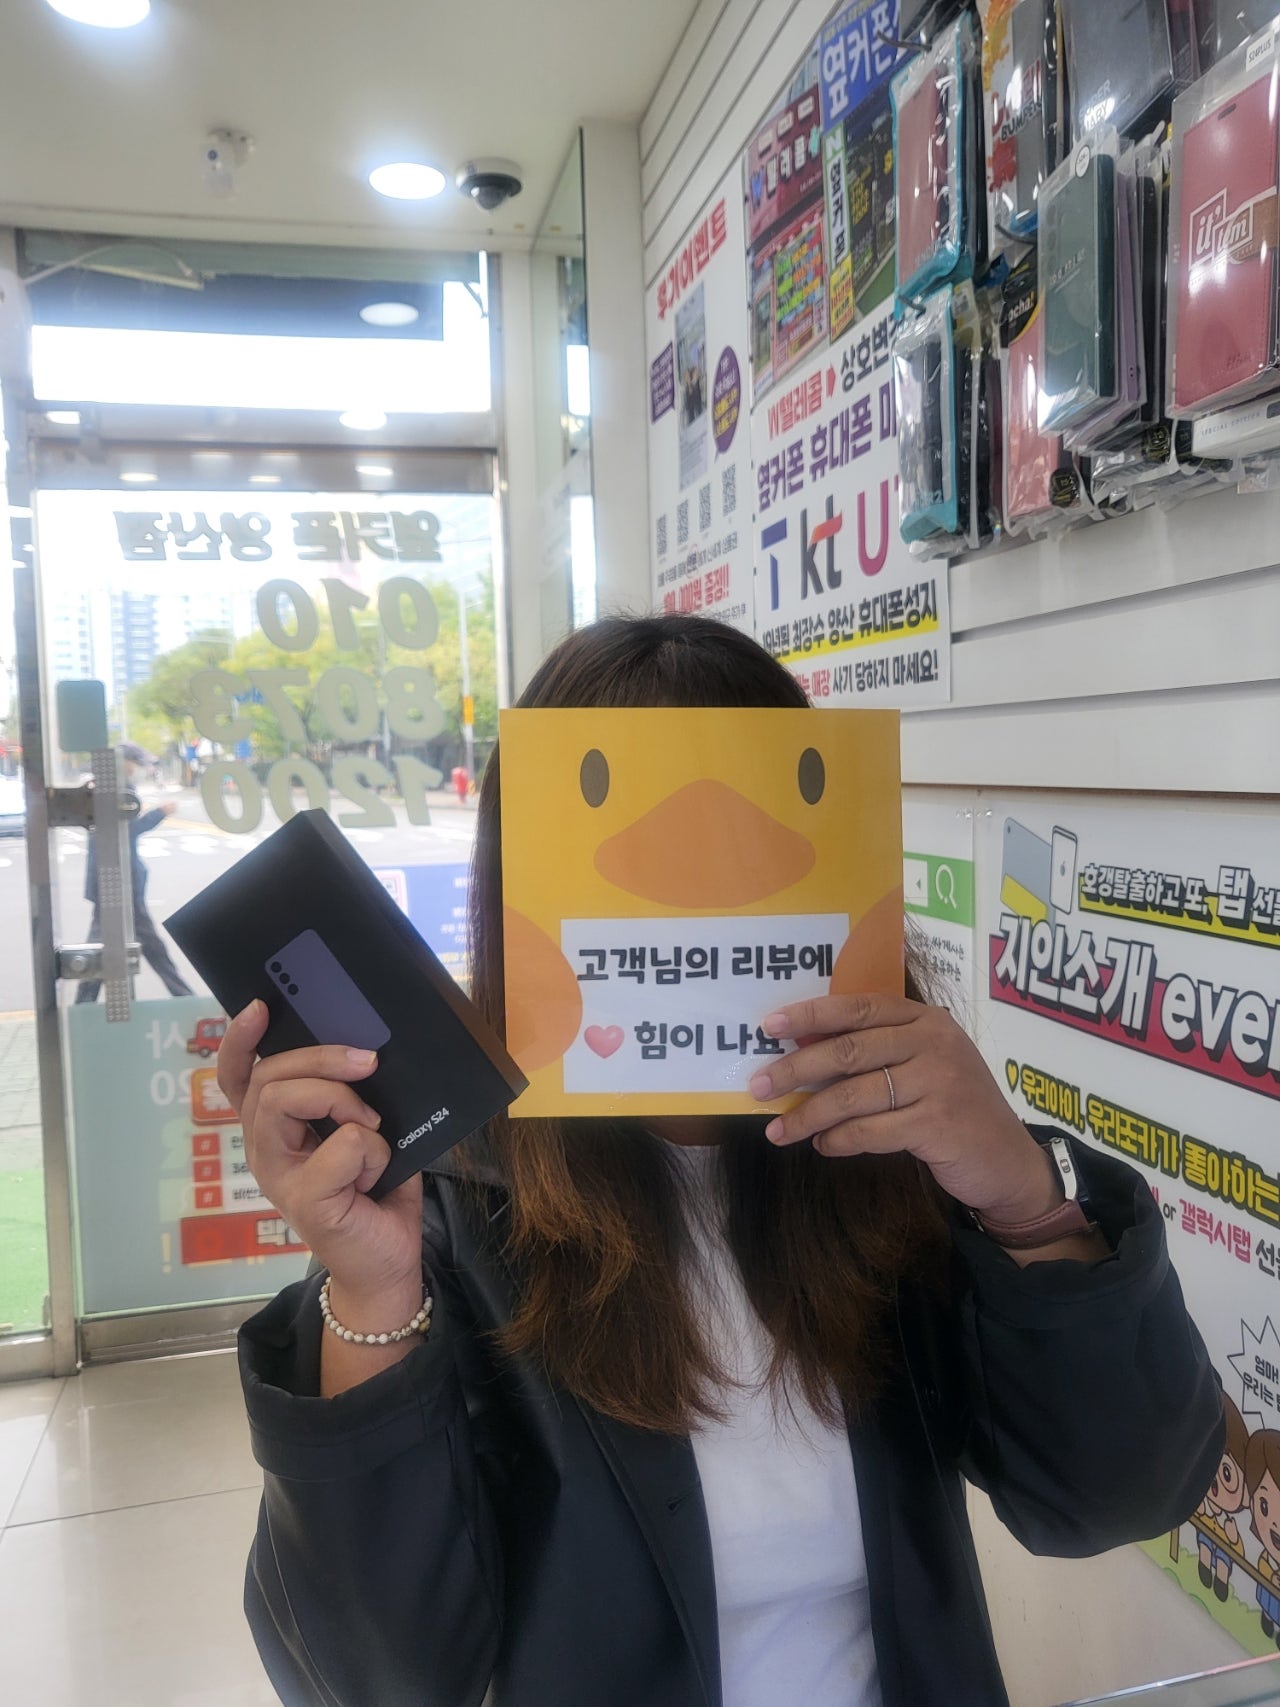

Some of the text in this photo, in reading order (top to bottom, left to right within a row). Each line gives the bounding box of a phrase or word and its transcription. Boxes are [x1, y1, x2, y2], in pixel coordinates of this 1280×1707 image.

[768, 370, 822, 441] W텔레콤
[810, 393, 873, 483] 휴대폰
[800, 494, 844, 601] kt
[792, 613, 825, 653] 최장수
[828, 604, 855, 646] 양산
[858, 579, 938, 638] 휴대폰성지
[832, 664, 853, 695] 사기
[855, 658, 890, 692] 당하지
[893, 649, 938, 687] 마세요!
[1081, 863, 1183, 909] 호갱탈출하고
[1217, 865, 1252, 922] 탭
[577, 943, 833, 985] 고객님의 리뷰에
[994, 912, 1157, 1034] 지인소개
[634, 1021, 786, 1060] 힘이 나요
[397, 1107, 450, 1149] Galaxy S24
[1021, 1066, 1280, 1222] 우리아이, 우리조카가 좋아하는
[1163, 1203, 1177, 1221] or
[1179, 1199, 1251, 1264] 갤럭시탭
[1243, 1371, 1274, 1408] 우리는
